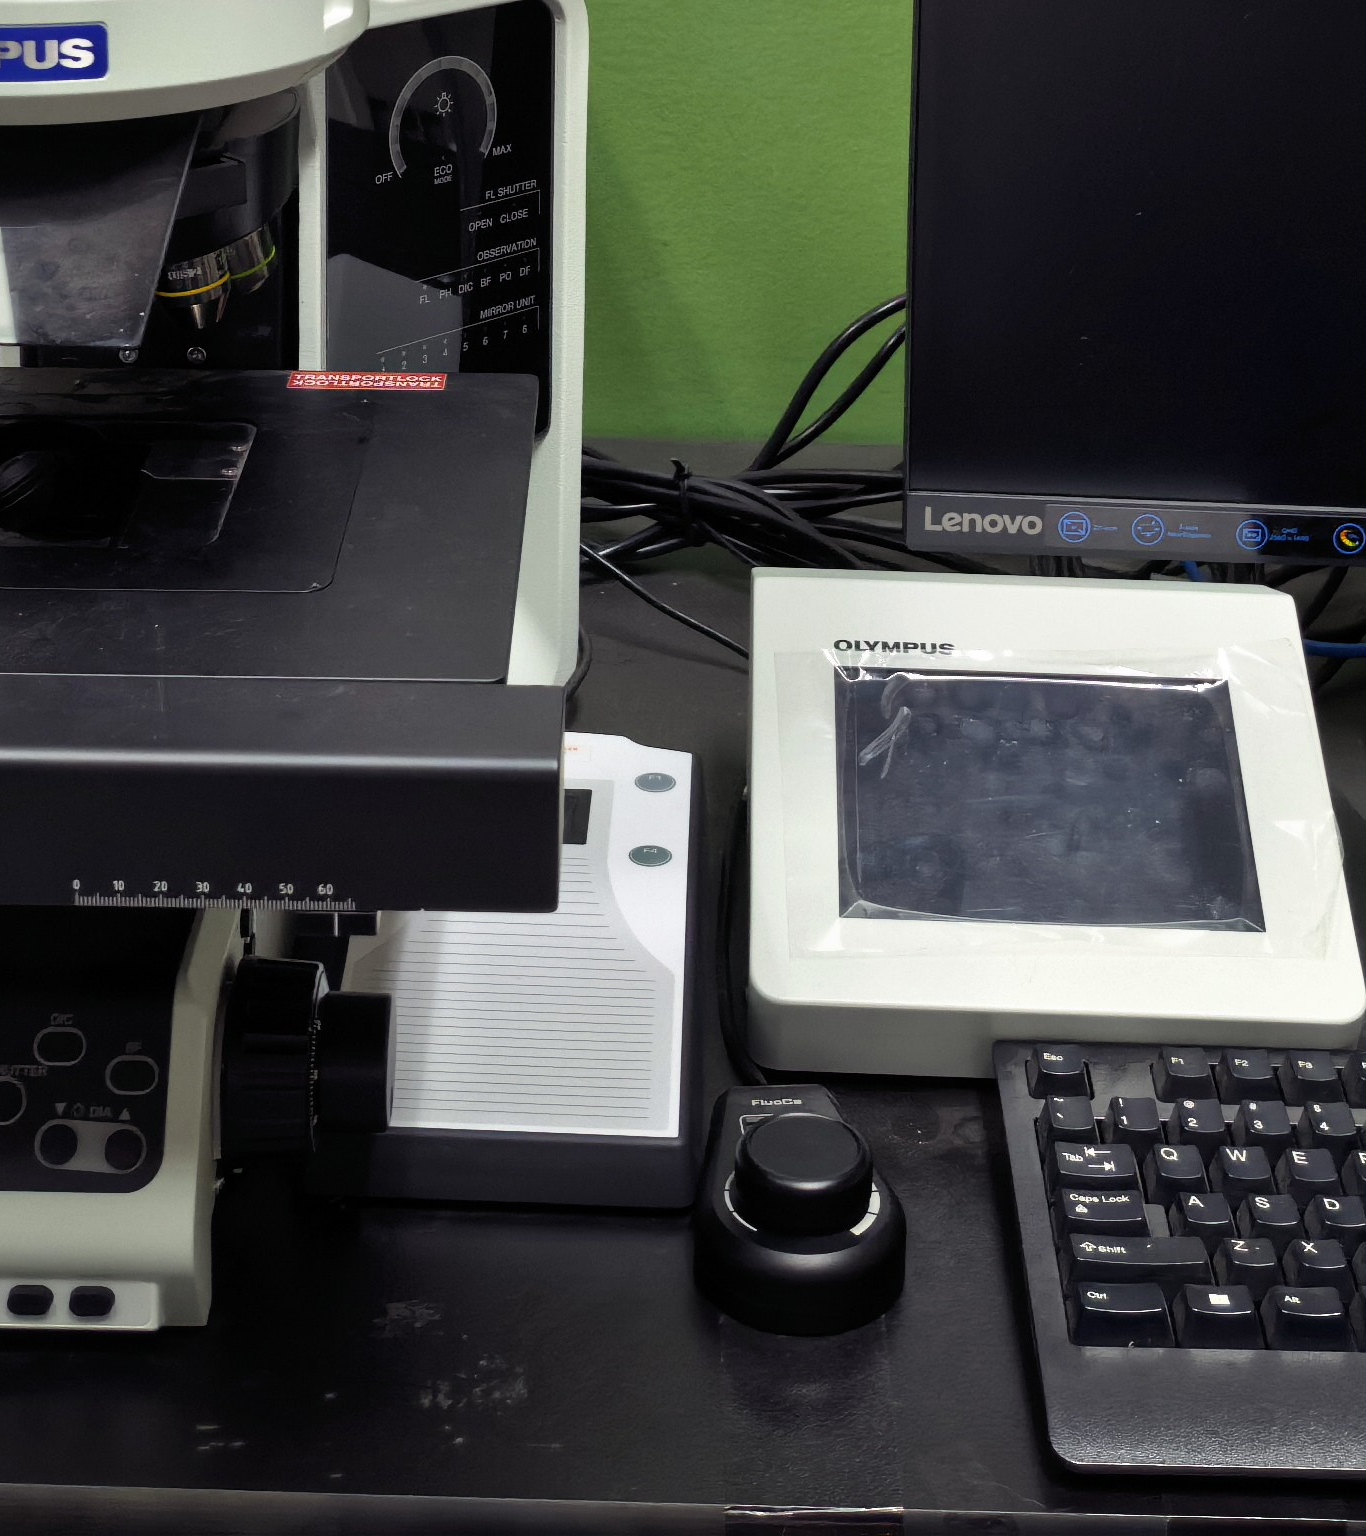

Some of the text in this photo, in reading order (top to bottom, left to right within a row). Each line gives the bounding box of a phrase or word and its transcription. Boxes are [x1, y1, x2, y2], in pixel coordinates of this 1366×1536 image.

[493, 144, 512, 156] MAX
[434, 164, 452, 176] ECO
[375, 172, 393, 184] OFF
[486, 180, 536, 199] FL SHUTTER
[468, 209, 528, 231] OPEN CLOSE
[477, 238, 536, 260] OBSERVATION
[420, 295, 430, 304] FL
[440, 288, 451, 299] PH
[459, 282, 473, 294] DIC
[481, 277, 491, 287] BF
[520, 266, 530, 276] DF
[480, 295, 535, 319] MIRROR UNIT
[402, 361, 406, 370] 2
[423, 355, 427, 363] 3
[463, 342, 468, 351] 5
[925, 506, 1043, 535] Lenovo
[834, 639, 955, 655] OLYMPUS
[73, 880, 333, 894] 0 10 20 30 40 50 60
[1235, 1059, 1249, 1067] F2
[1062, 1152, 1084, 1162] Tab
[1161, 1147, 1178, 1161] Q
[1225, 1148, 1248, 1162] W
[1292, 1152, 1309, 1164] E
[1069, 1193, 1129, 1204] Caps Lock
[1188, 1196, 1204, 1207] A
[1255, 1197, 1270, 1209] S
[1323, 1198, 1339, 1210] D
[1098, 1244, 1126, 1254] Shift
[1233, 1240, 1249, 1251] Z
[1302, 1242, 1318, 1253] X
[1087, 1290, 1107, 1299] Ctrl
